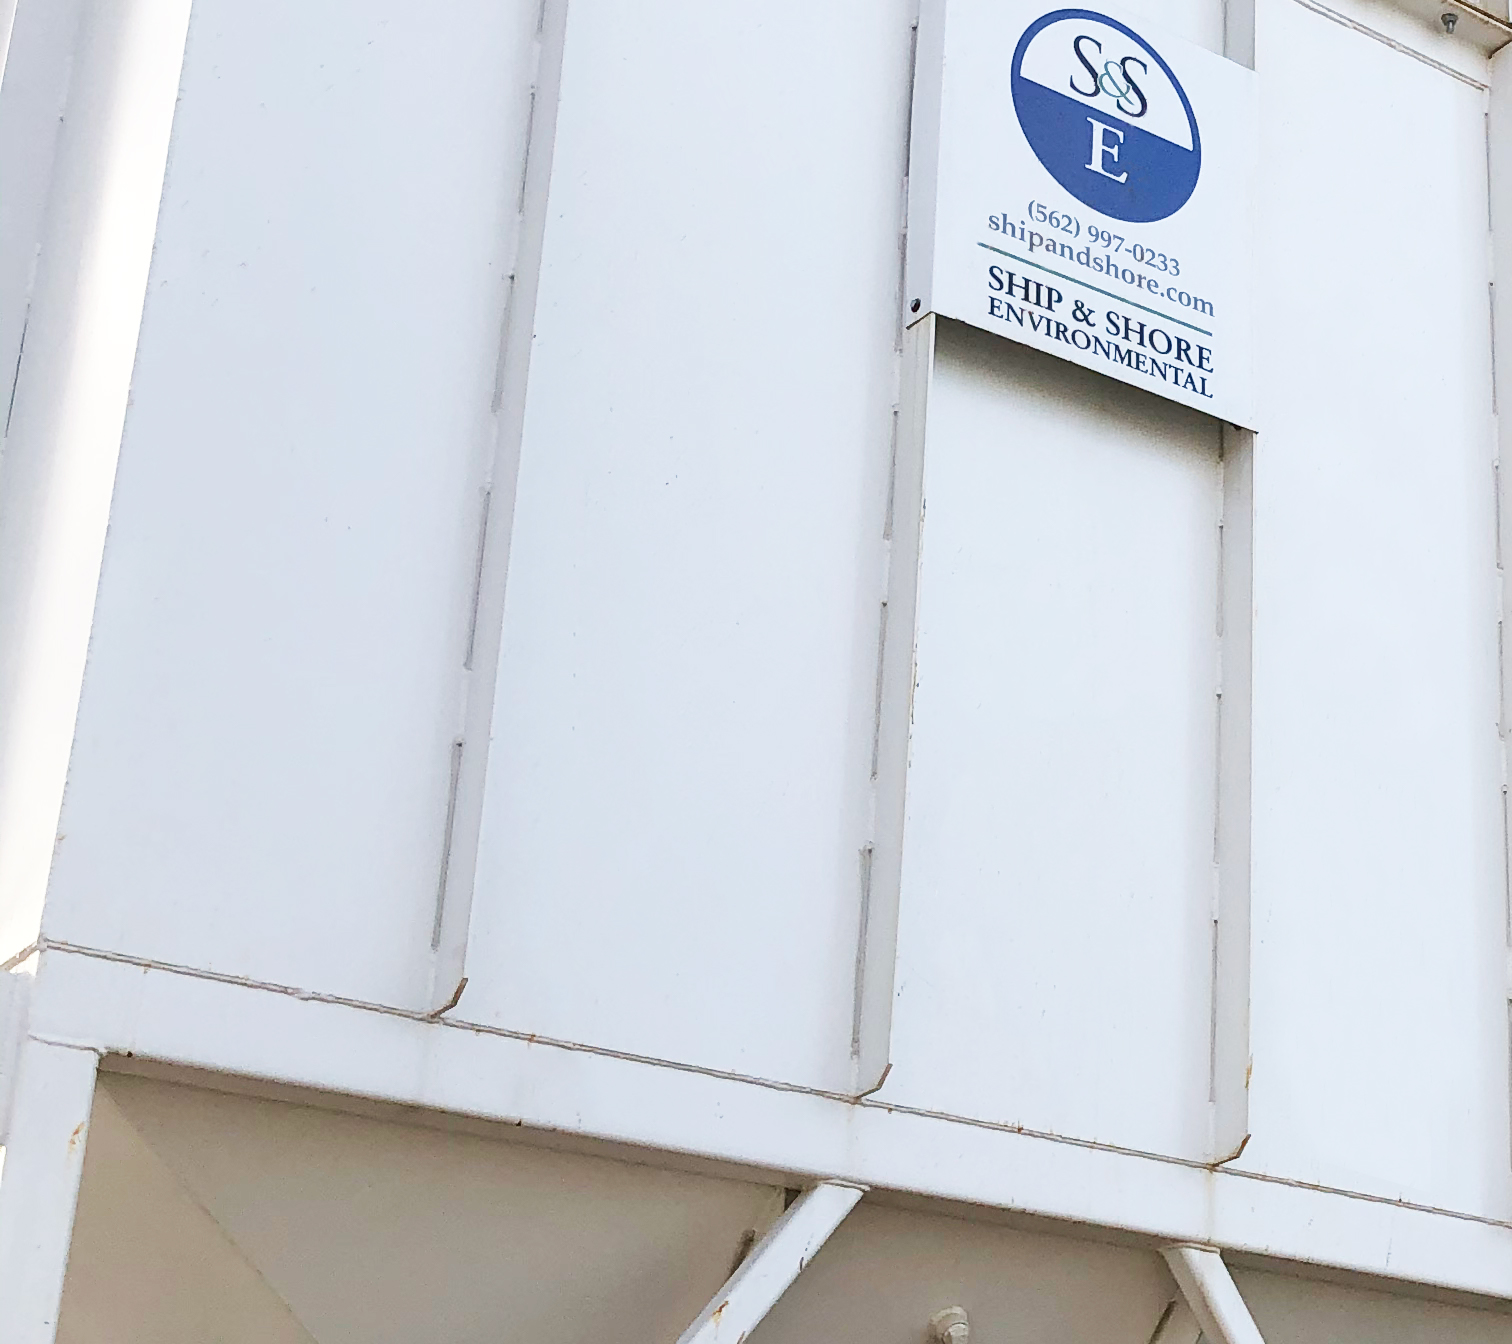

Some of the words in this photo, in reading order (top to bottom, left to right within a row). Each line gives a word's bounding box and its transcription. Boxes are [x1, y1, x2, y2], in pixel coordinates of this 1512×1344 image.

[1069, 35, 1148, 118] S&S
[1084, 116, 1128, 184] E
[988, 213, 1215, 317] shipandshore.com
[1027, 199, 1081, 238] (562)
[1087, 225, 1181, 277] 997-0233
[988, 265, 1063, 313] SHIP
[1071, 299, 1096, 327] &
[1105, 310, 1214, 373] SHORE
[988, 295, 1214, 399] ENVIRONMENTAL
